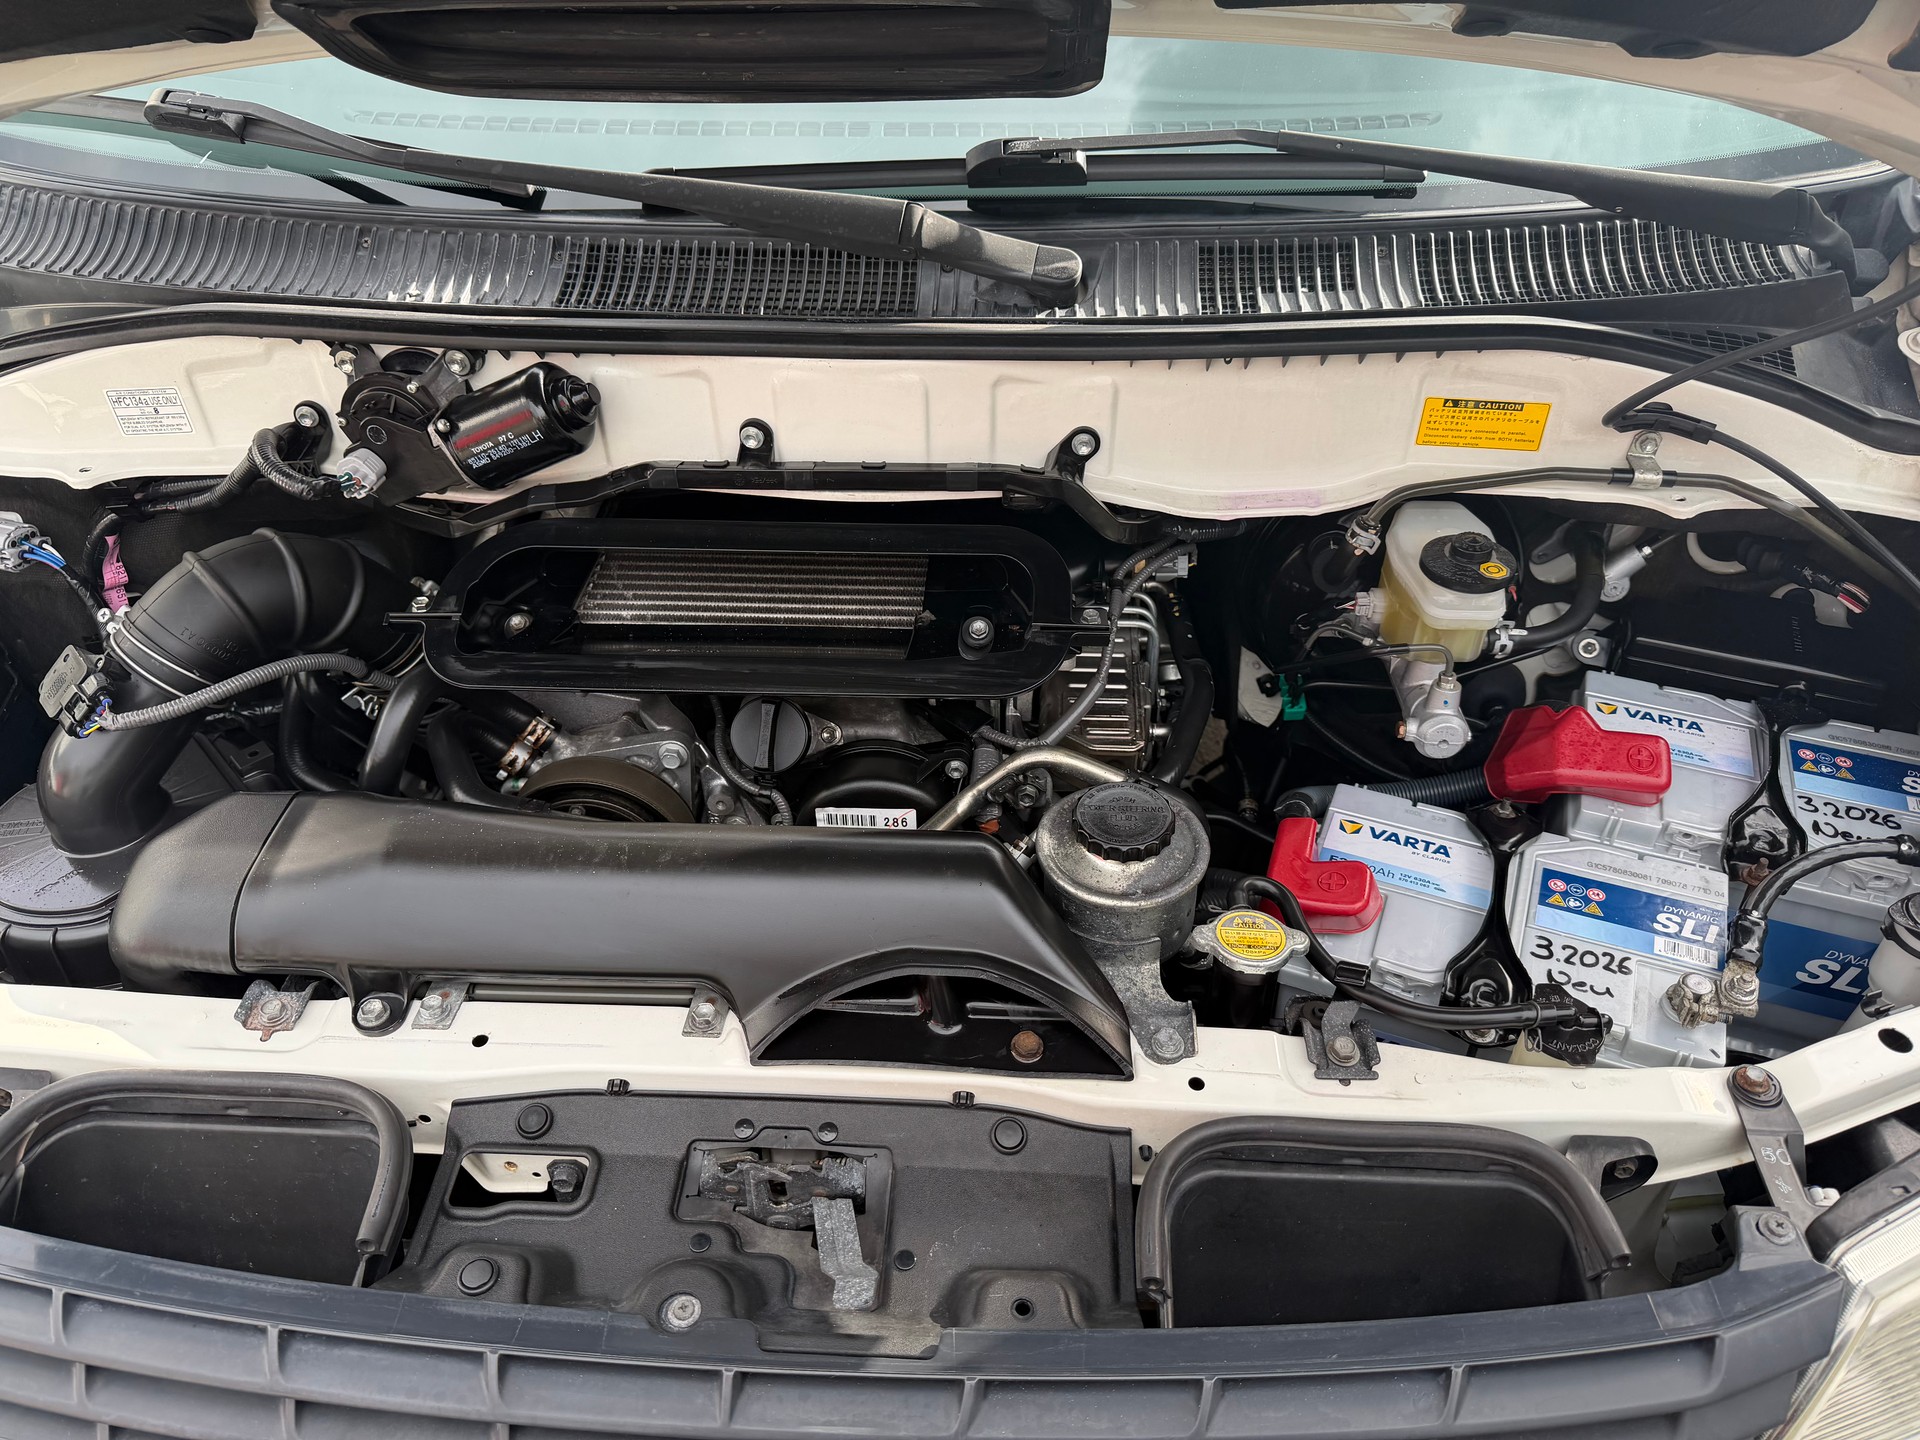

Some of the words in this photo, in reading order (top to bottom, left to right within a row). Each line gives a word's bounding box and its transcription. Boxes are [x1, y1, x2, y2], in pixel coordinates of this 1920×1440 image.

[111, 396, 149, 406] HFC134a
[148, 396, 162, 406] USE
[162, 396, 178, 405] ONLY
[1458, 400, 1476, 408] 注意
[1479, 402, 1522, 410] CAUTION
[471, 442, 494, 454] TOYOTA
[498, 434, 506, 444] P7
[526, 430, 544, 444] LH
[472, 458, 490, 469] ASMO
[1624, 706, 1704, 732] VARTA
[1678, 729, 1706, 738] CLARIOS
[1902, 776, 1920, 794] S
[1797, 796, 1902, 830] 3.2026
[884, 817, 908, 828] 286
[1812, 820, 1873, 840] Ne
[1369, 826, 1450, 858] VARTA
[1422, 854, 1450, 864] CLARIOS
[1368, 866, 1395, 878] 0Ah
[1714, 890, 1725, 898] 04
[1664, 906, 1718, 924] DYNAMIC
[1653, 912, 1720, 944] SLI
[1530, 935, 1632, 975] 3.2026
[1825, 950, 1868, 966] DYNA
[1547, 968, 1614, 998] Neu
[1796, 959, 1870, 996] SL
[1549, 1038, 1600, 1052] COOLANT
